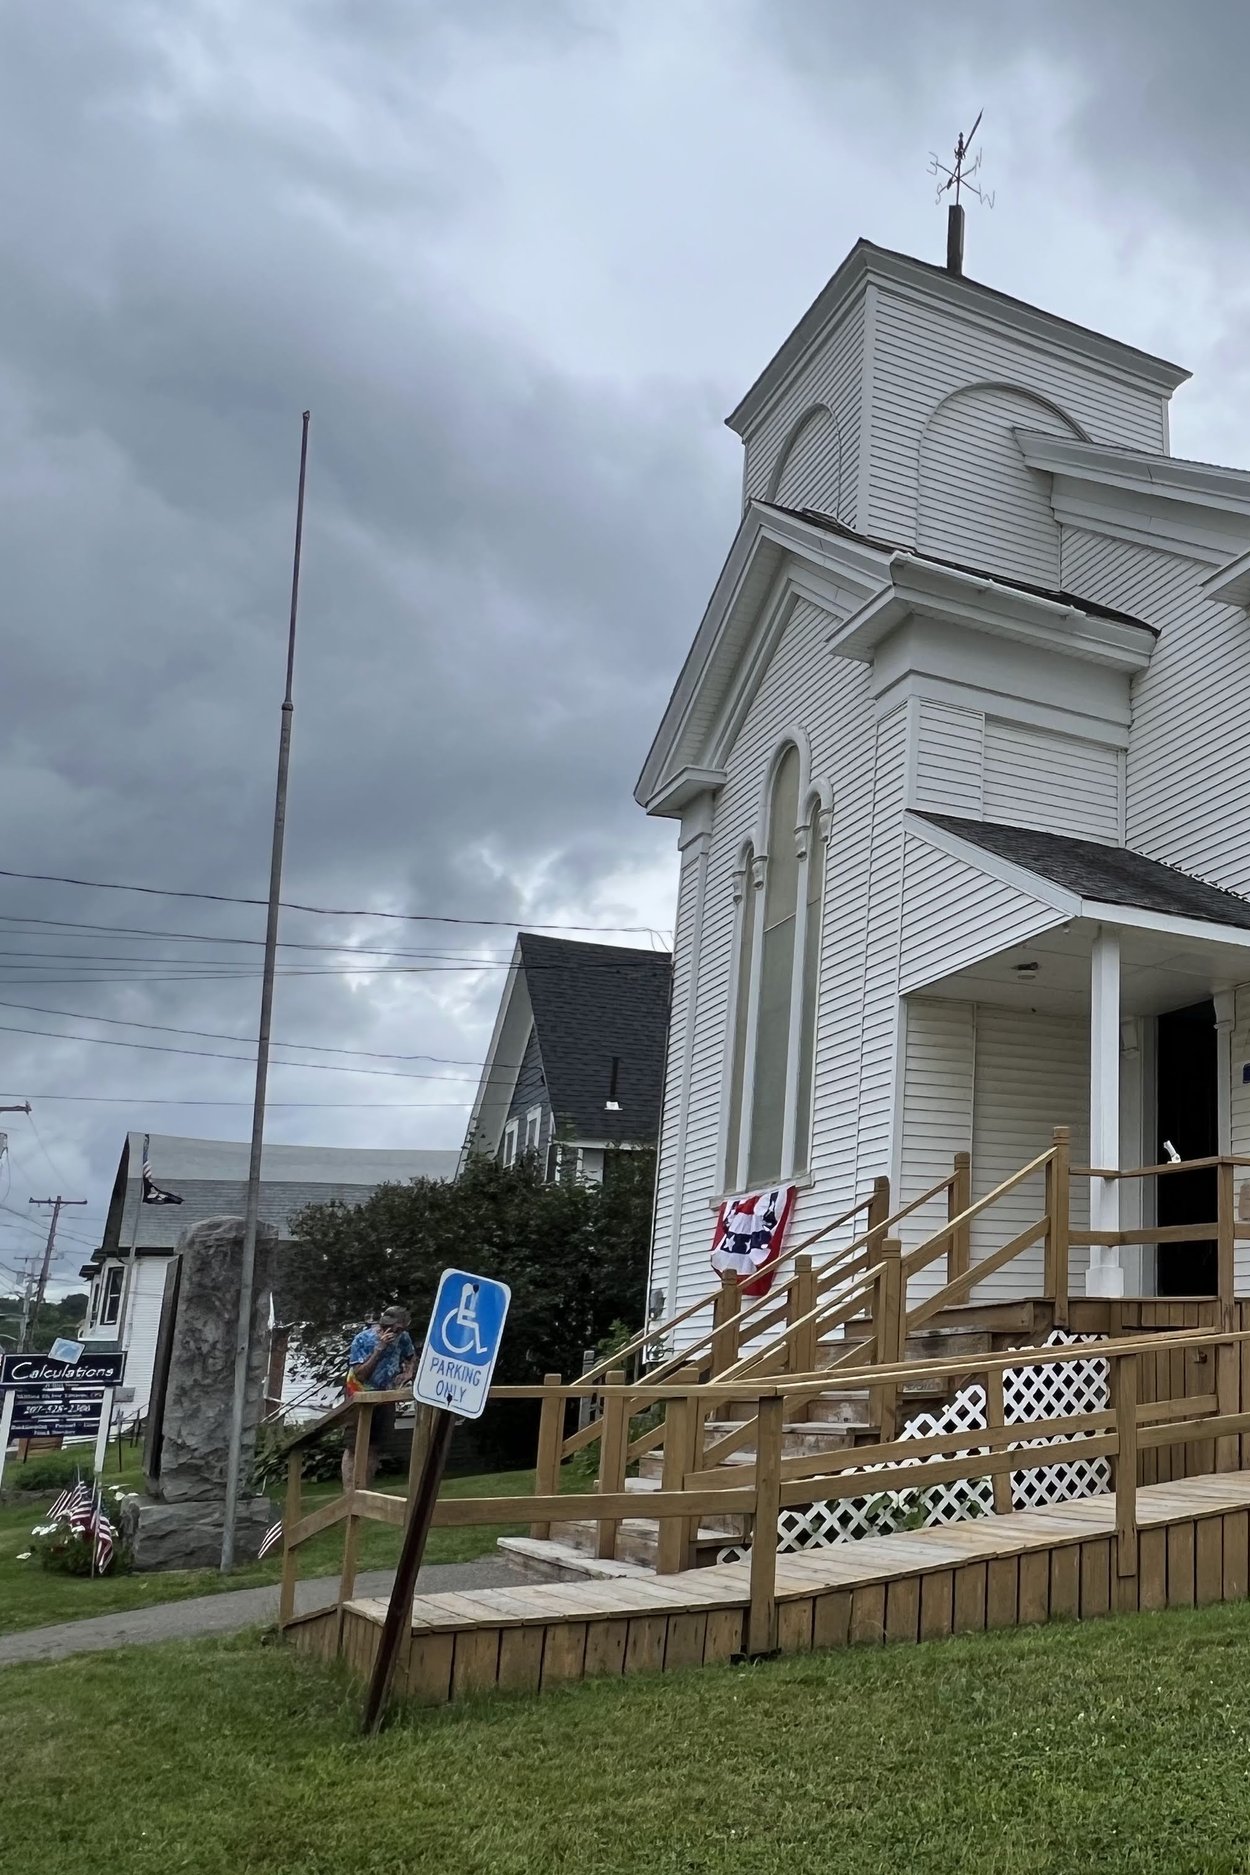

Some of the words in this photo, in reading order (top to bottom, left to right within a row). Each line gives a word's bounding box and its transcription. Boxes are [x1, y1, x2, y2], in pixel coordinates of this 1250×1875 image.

[11, 1361, 114, 1380] Calculations
[429, 1356, 482, 1387] PARKING
[435, 1379, 467, 1403] ONLY
